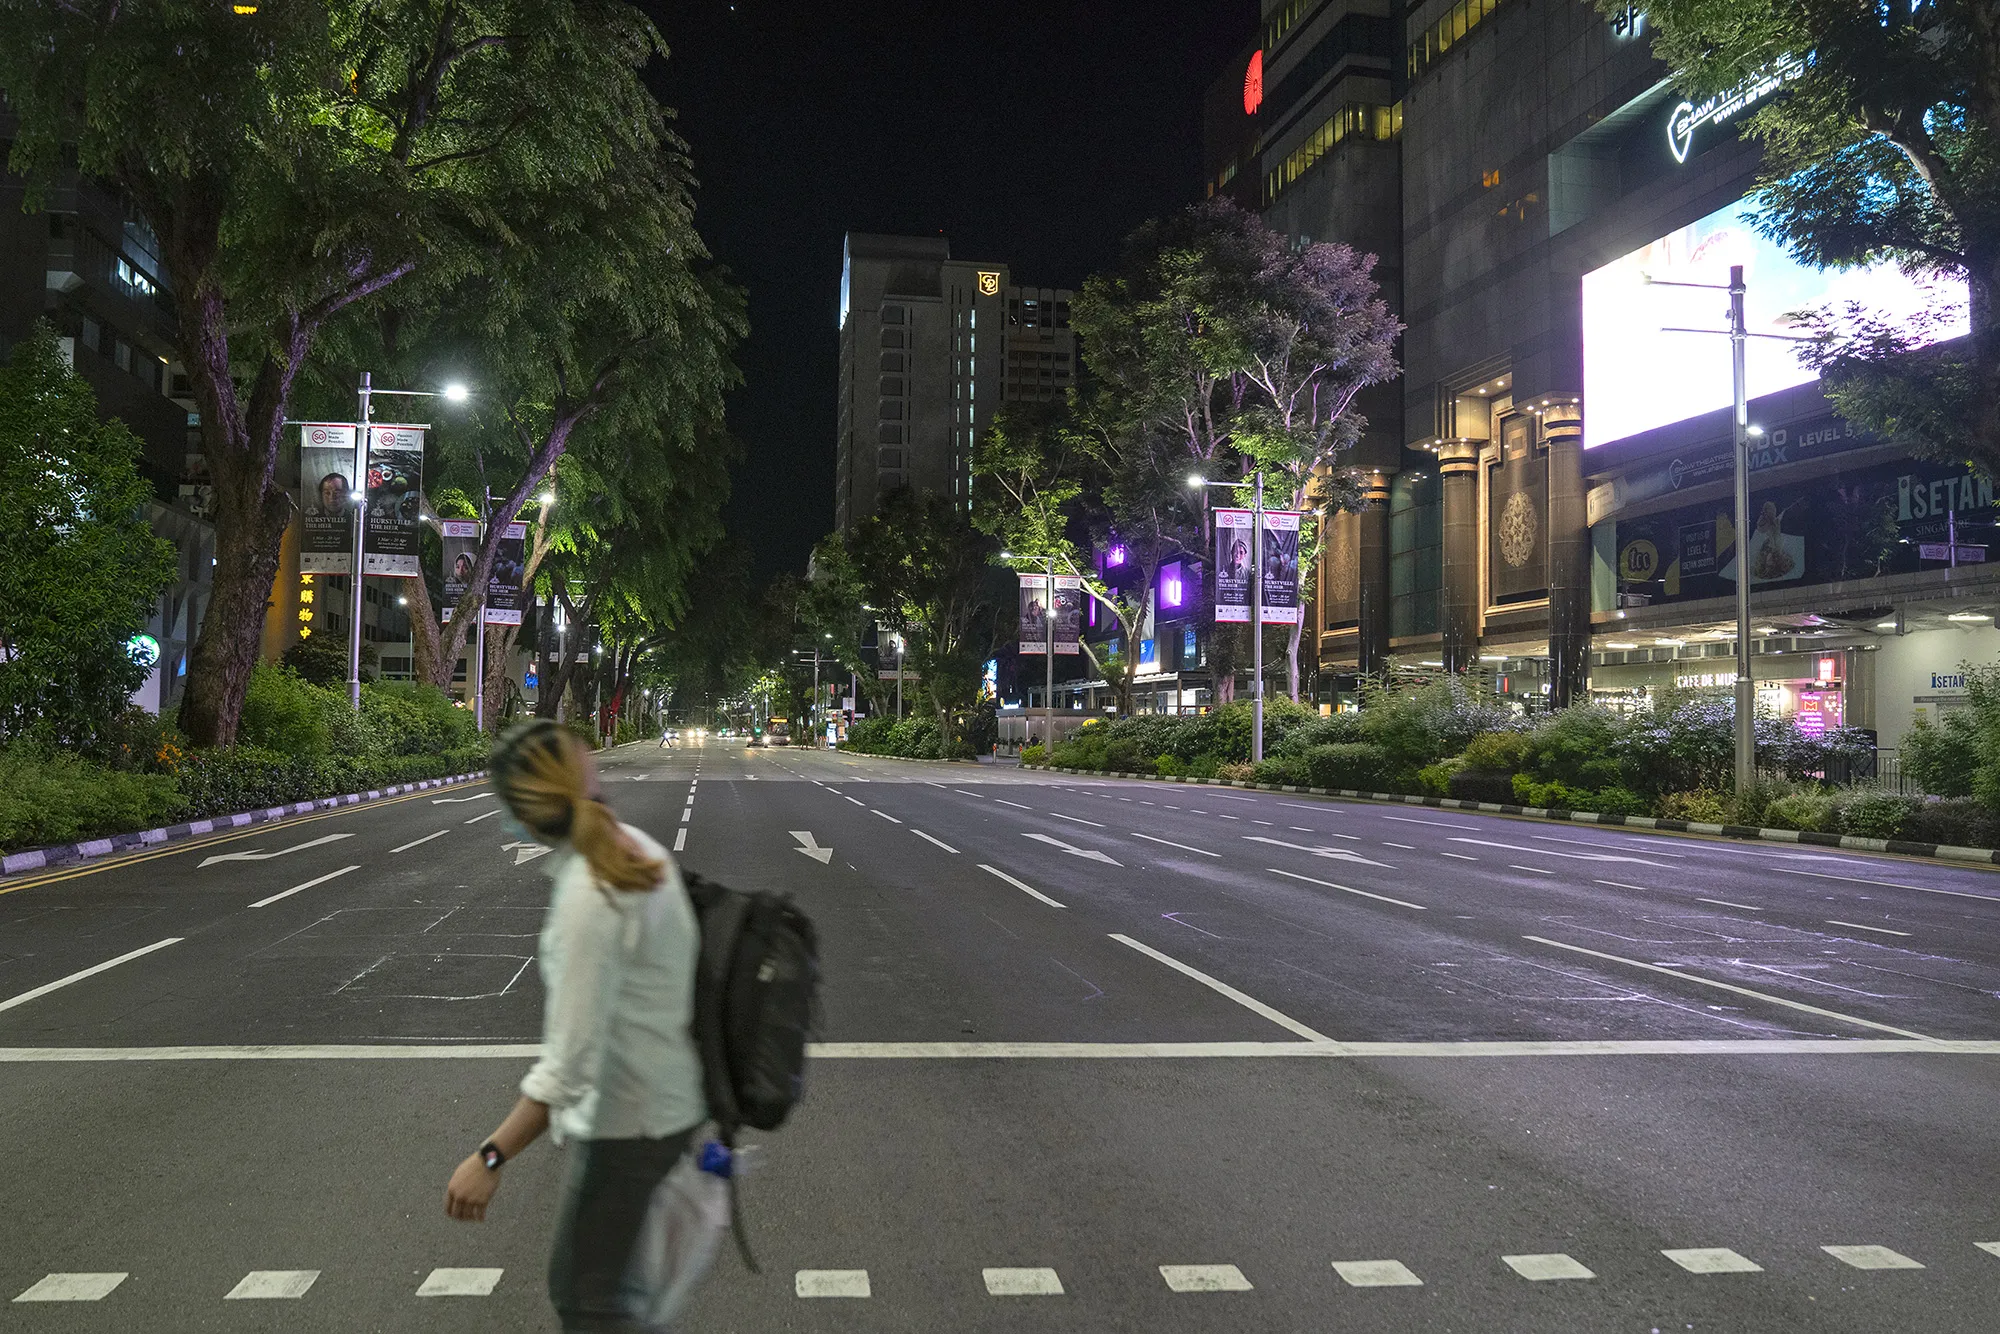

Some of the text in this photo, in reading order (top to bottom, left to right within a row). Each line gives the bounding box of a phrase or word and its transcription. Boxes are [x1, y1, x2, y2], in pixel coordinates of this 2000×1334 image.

[1713, 63, 1805, 125] www.shawsg
[1677, 96, 1715, 134] SHAW
[1800, 429, 1841, 448] LEVEL
[1749, 447, 1788, 471] MAX
[1897, 475, 1993, 521] ISETAN
[1629, 548, 1650, 571] tcc
[1677, 674, 1699, 688] CAFE
[1701, 675, 1713, 687] DE
[1931, 672, 1965, 688] ISETAN
